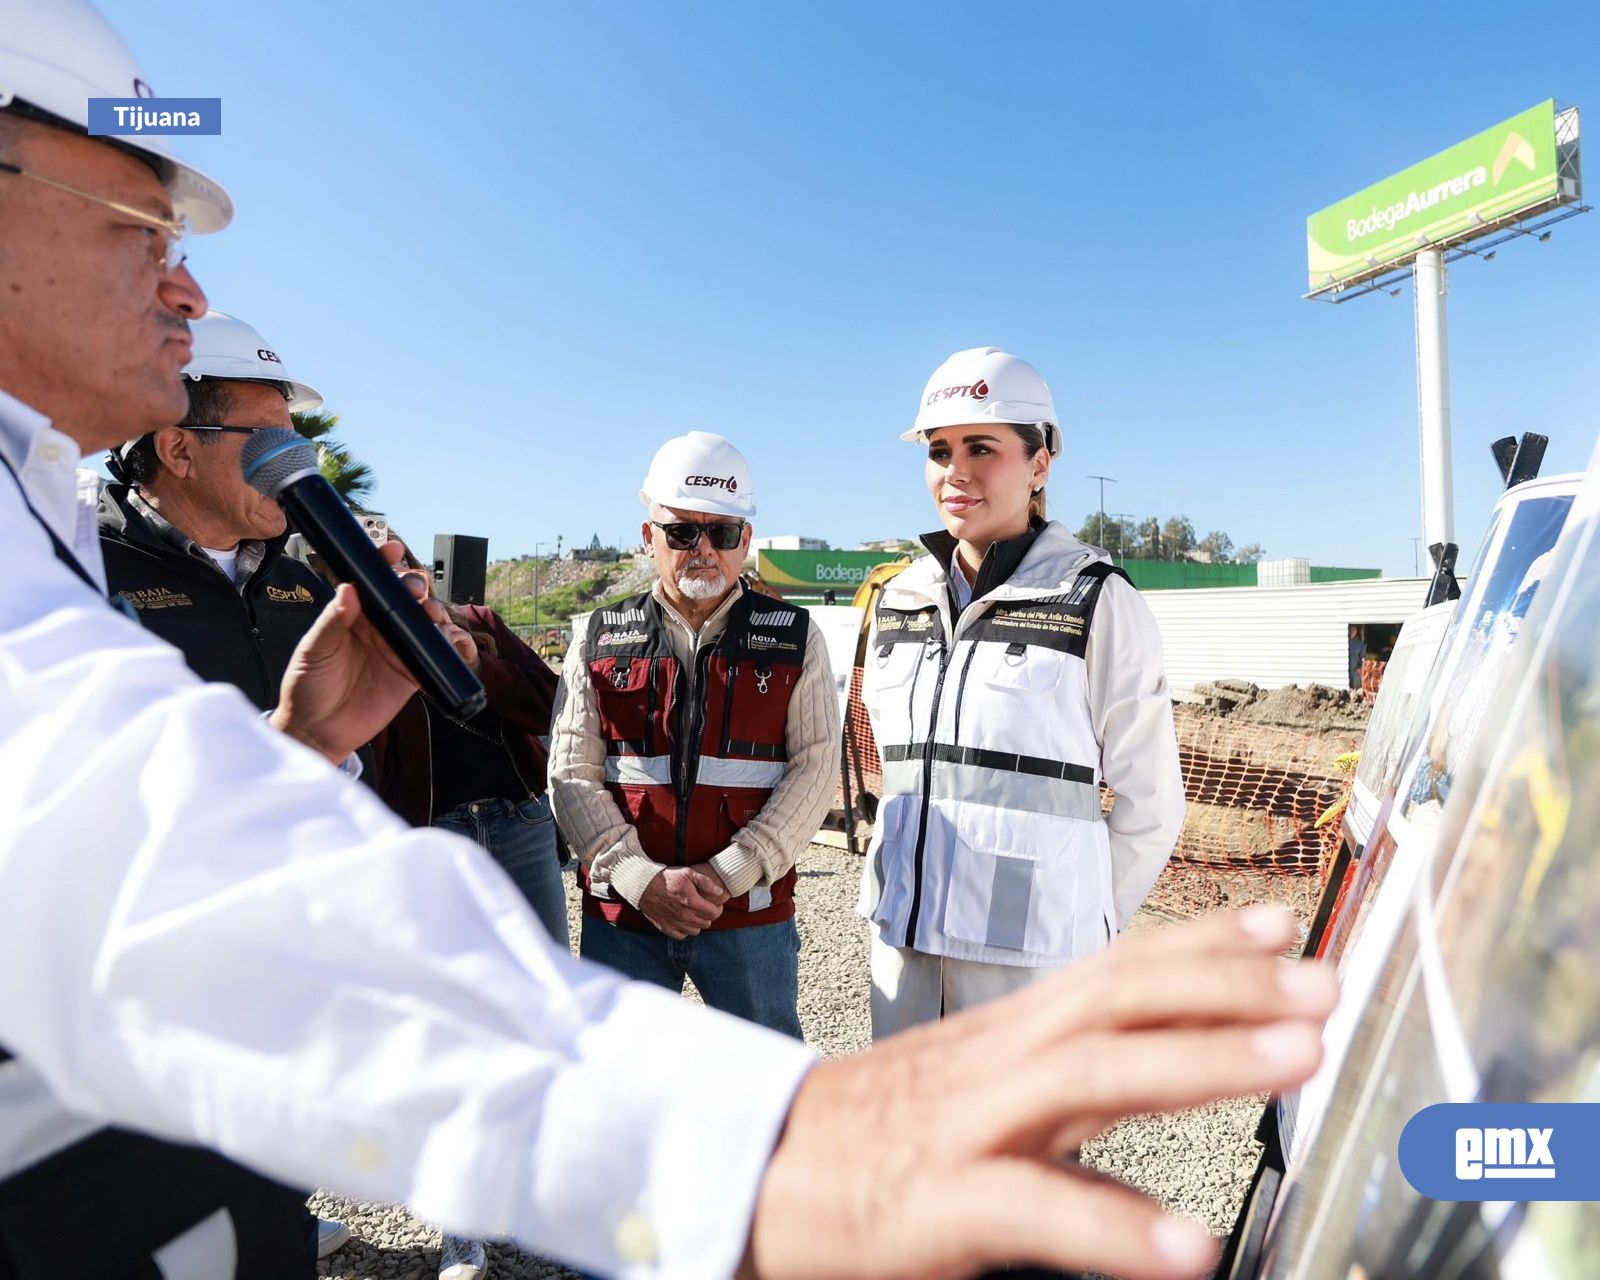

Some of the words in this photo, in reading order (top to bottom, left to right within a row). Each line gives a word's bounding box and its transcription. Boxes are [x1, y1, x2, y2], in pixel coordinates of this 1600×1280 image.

[926, 385, 972, 407] CESPT
[684, 475, 727, 489] CESPT
[266, 585, 298, 600] CESPT
[751, 634, 778, 643] AGUA
